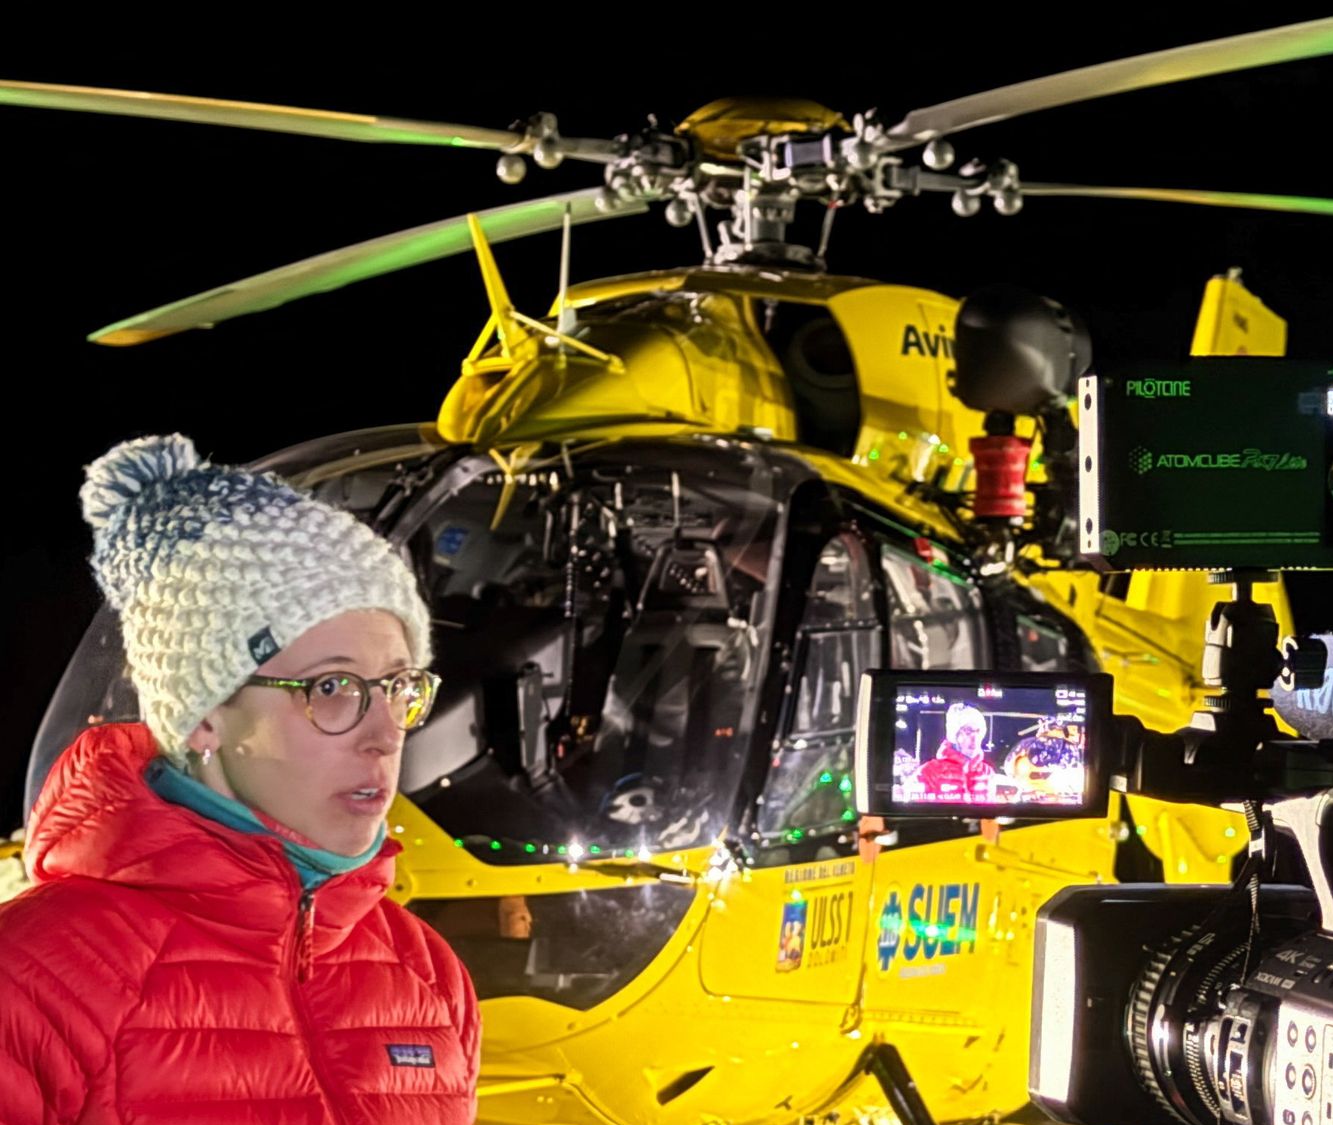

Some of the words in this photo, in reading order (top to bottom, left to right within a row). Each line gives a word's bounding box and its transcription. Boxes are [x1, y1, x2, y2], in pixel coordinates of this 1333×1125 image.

[902, 324, 957, 358] Avi
[1156, 454, 1240, 468] ATOMCUBE
[903, 883, 979, 961] SUEM
